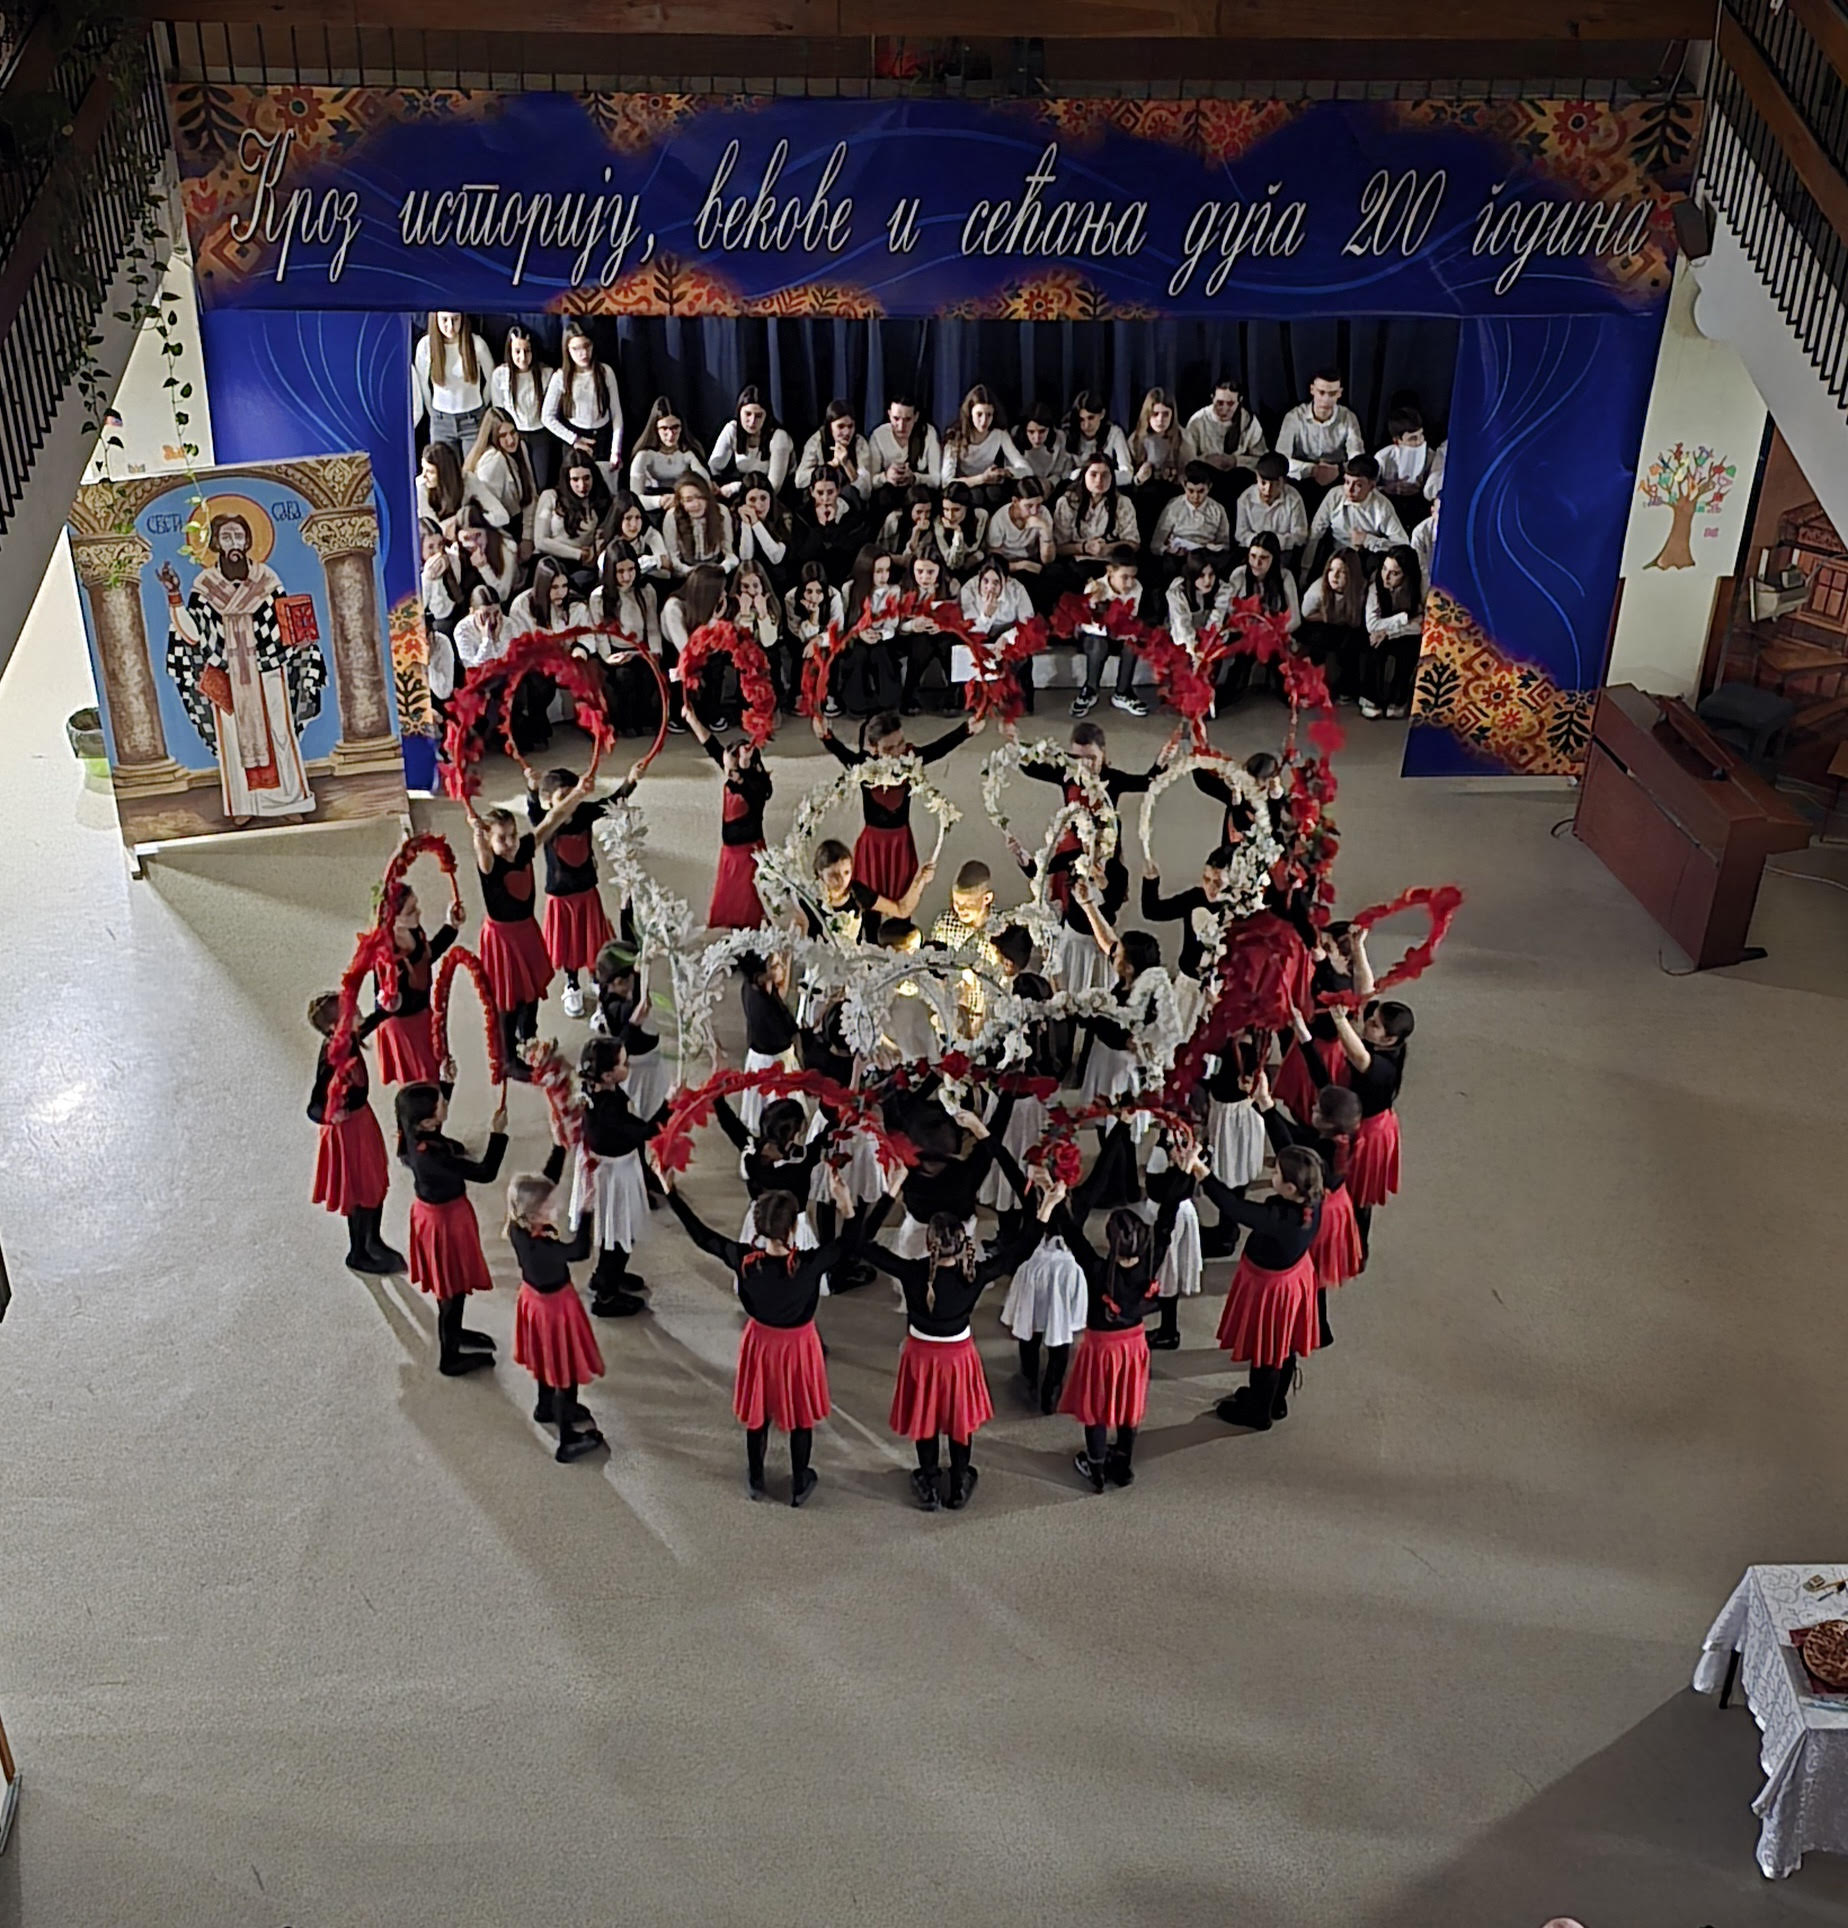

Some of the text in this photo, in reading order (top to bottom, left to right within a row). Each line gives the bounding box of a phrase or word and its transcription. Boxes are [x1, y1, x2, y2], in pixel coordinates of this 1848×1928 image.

[230, 127, 1652, 296] Кроз историју, векове и сећања дуга 200 година
